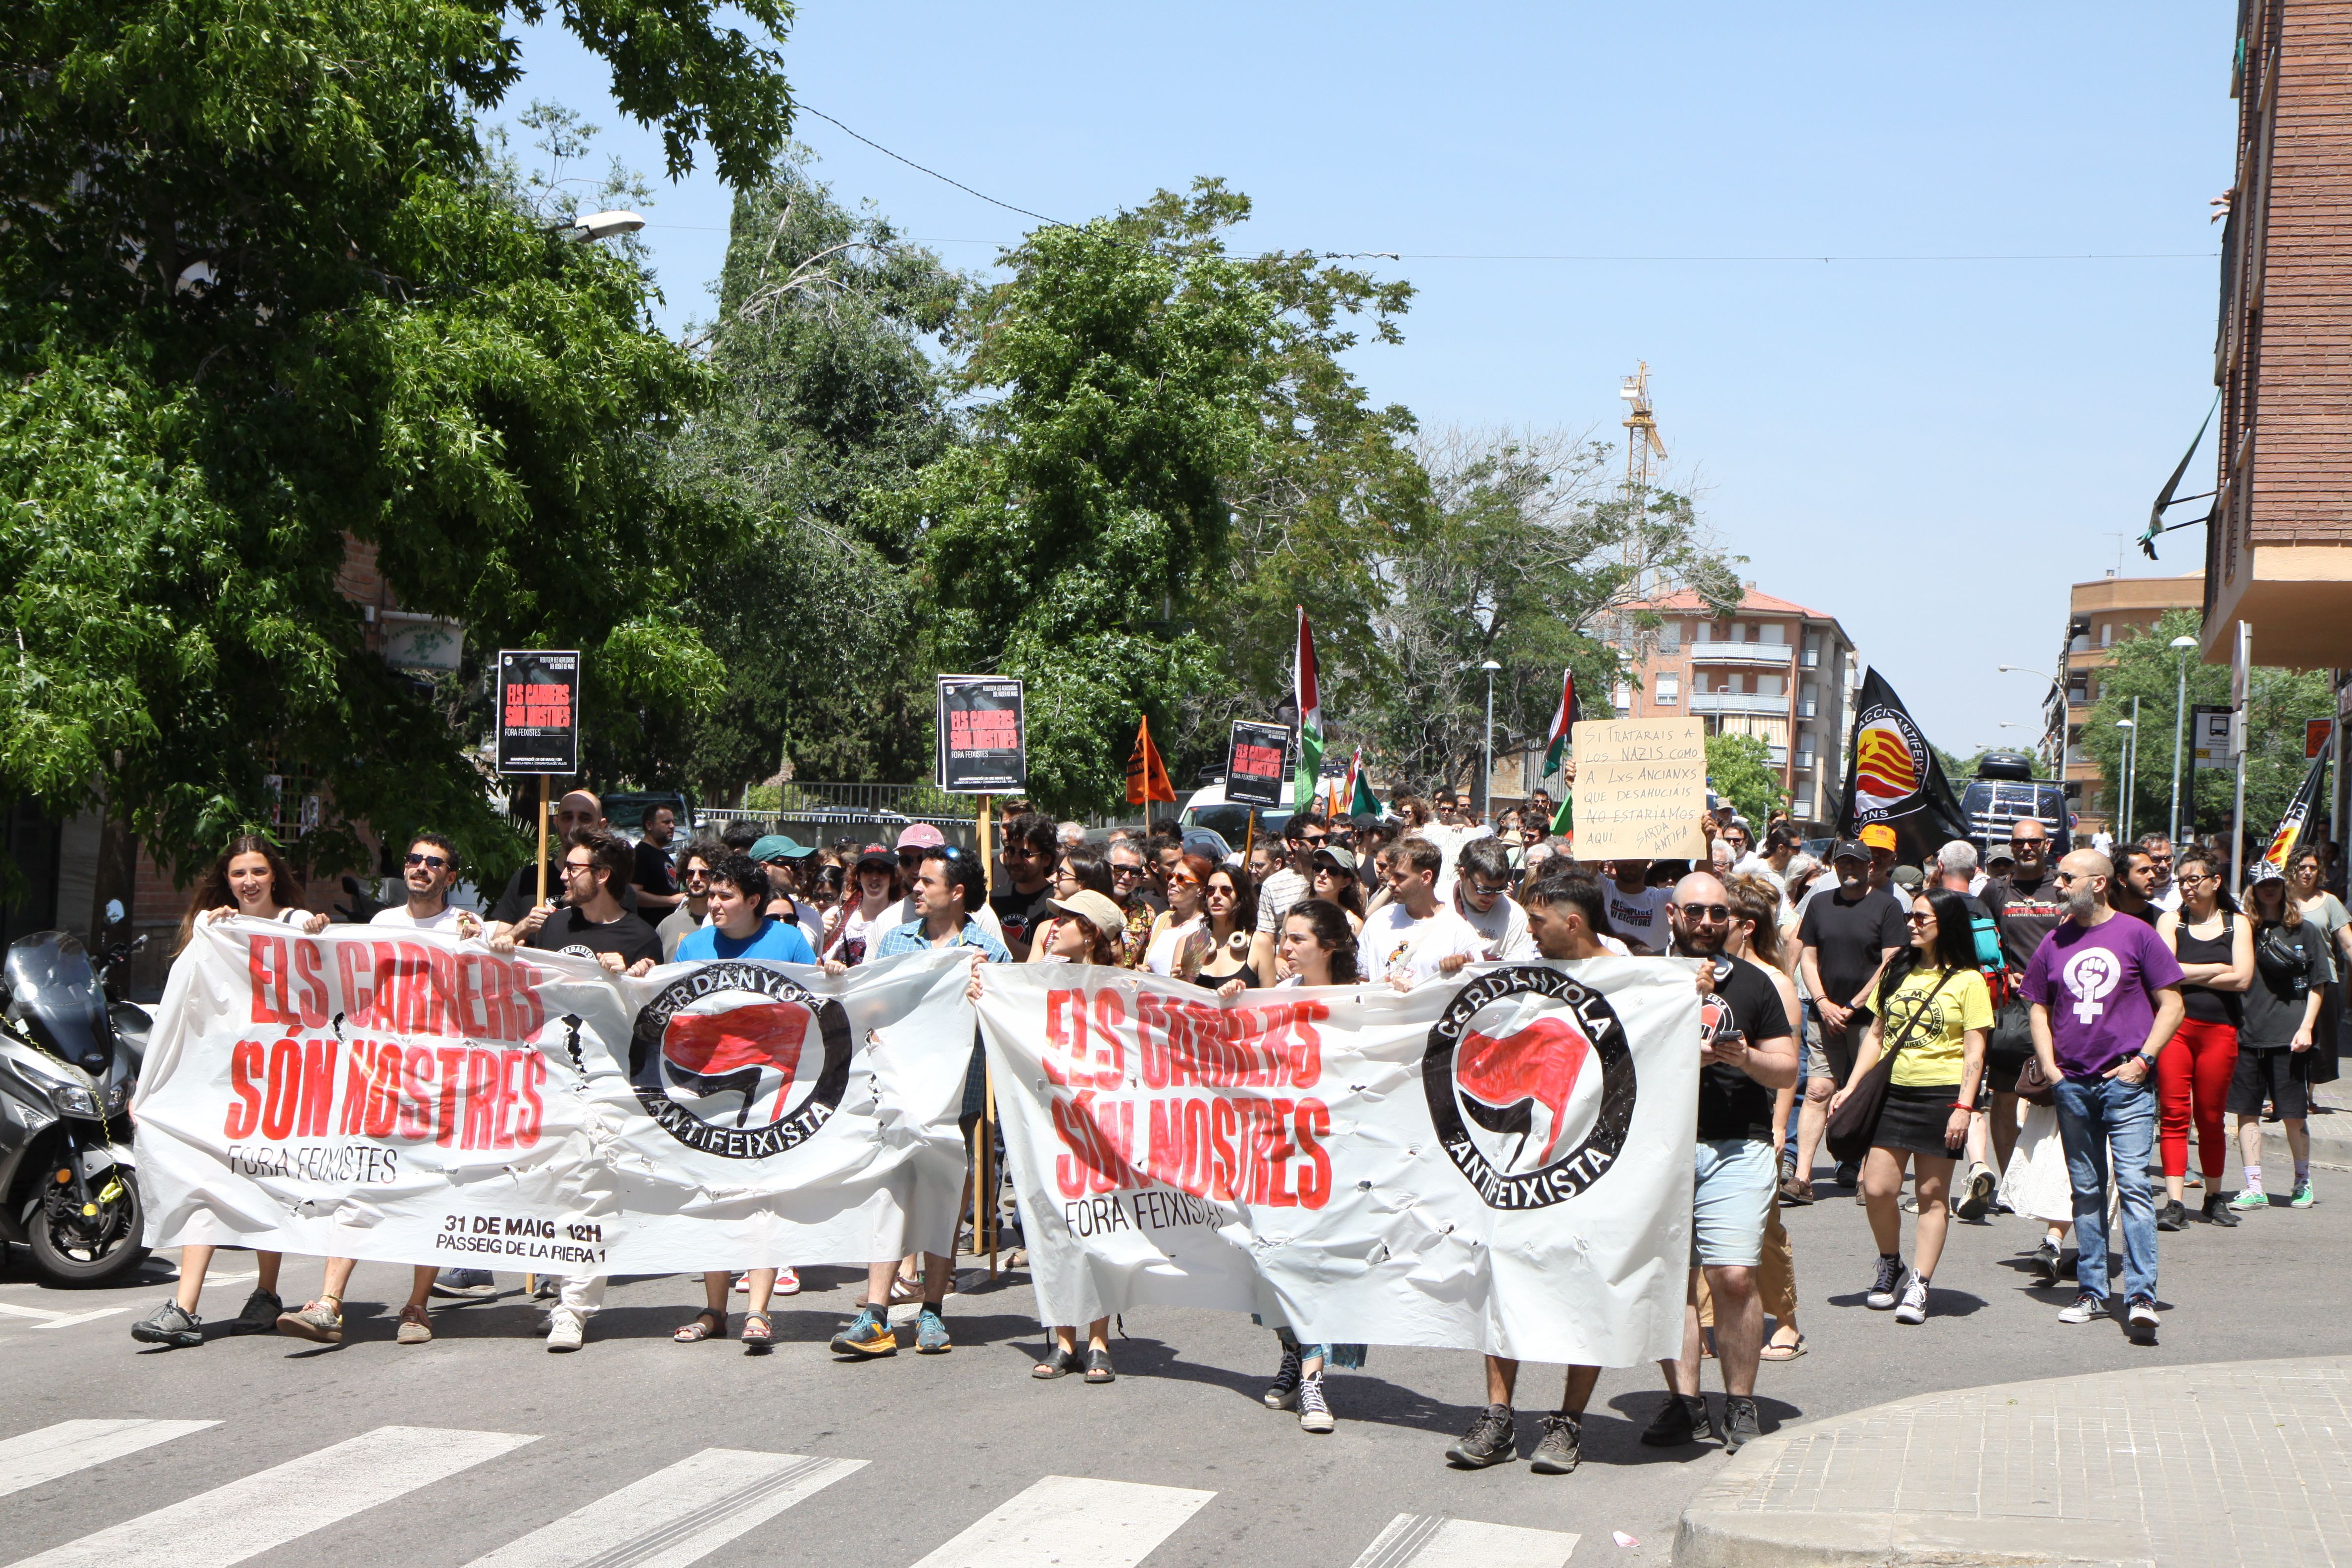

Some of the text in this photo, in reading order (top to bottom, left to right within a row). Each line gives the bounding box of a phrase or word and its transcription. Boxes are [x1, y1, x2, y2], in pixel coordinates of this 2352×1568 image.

[507, 684, 569, 706] ELS CARRERS
[505, 702, 570, 727] SÓN NOSTRES
[951, 710, 1015, 731] ELS CARRERS
[973, 730, 1018, 750] NOSTRES
[1585, 725, 1695, 745] SI TRATARAIS A
[1585, 746, 1698, 763] LOS NAZIS COMO
[1585, 771, 1595, 784] A
[1584, 792, 1606, 805] QUE
[1587, 809, 1606, 826] NO
[1611, 898, 1619, 908] NI
[249, 934, 545, 1043] ELS CARRERS
[1928, 1008, 1942, 1039] VIOLENTAS
[1042, 987, 1330, 1090] ELS CARRERS
[224, 1026, 547, 1151] SÓN NOSTRES
[649, 1098, 833, 1157] ANTIFEIXISTA
[1051, 1089, 1332, 1211] SÓN NOSTRES
[225, 1145, 397, 1184] FORA FEIXISTES
[1450, 1140, 1612, 1208] ANTIFEIXISTA
[445, 1215, 601, 1242] 31 DE MAIG 12H
[1065, 1194, 1130, 1239] FORA
[436, 1234, 605, 1263] PASSEIG DE LA RIERA 1
